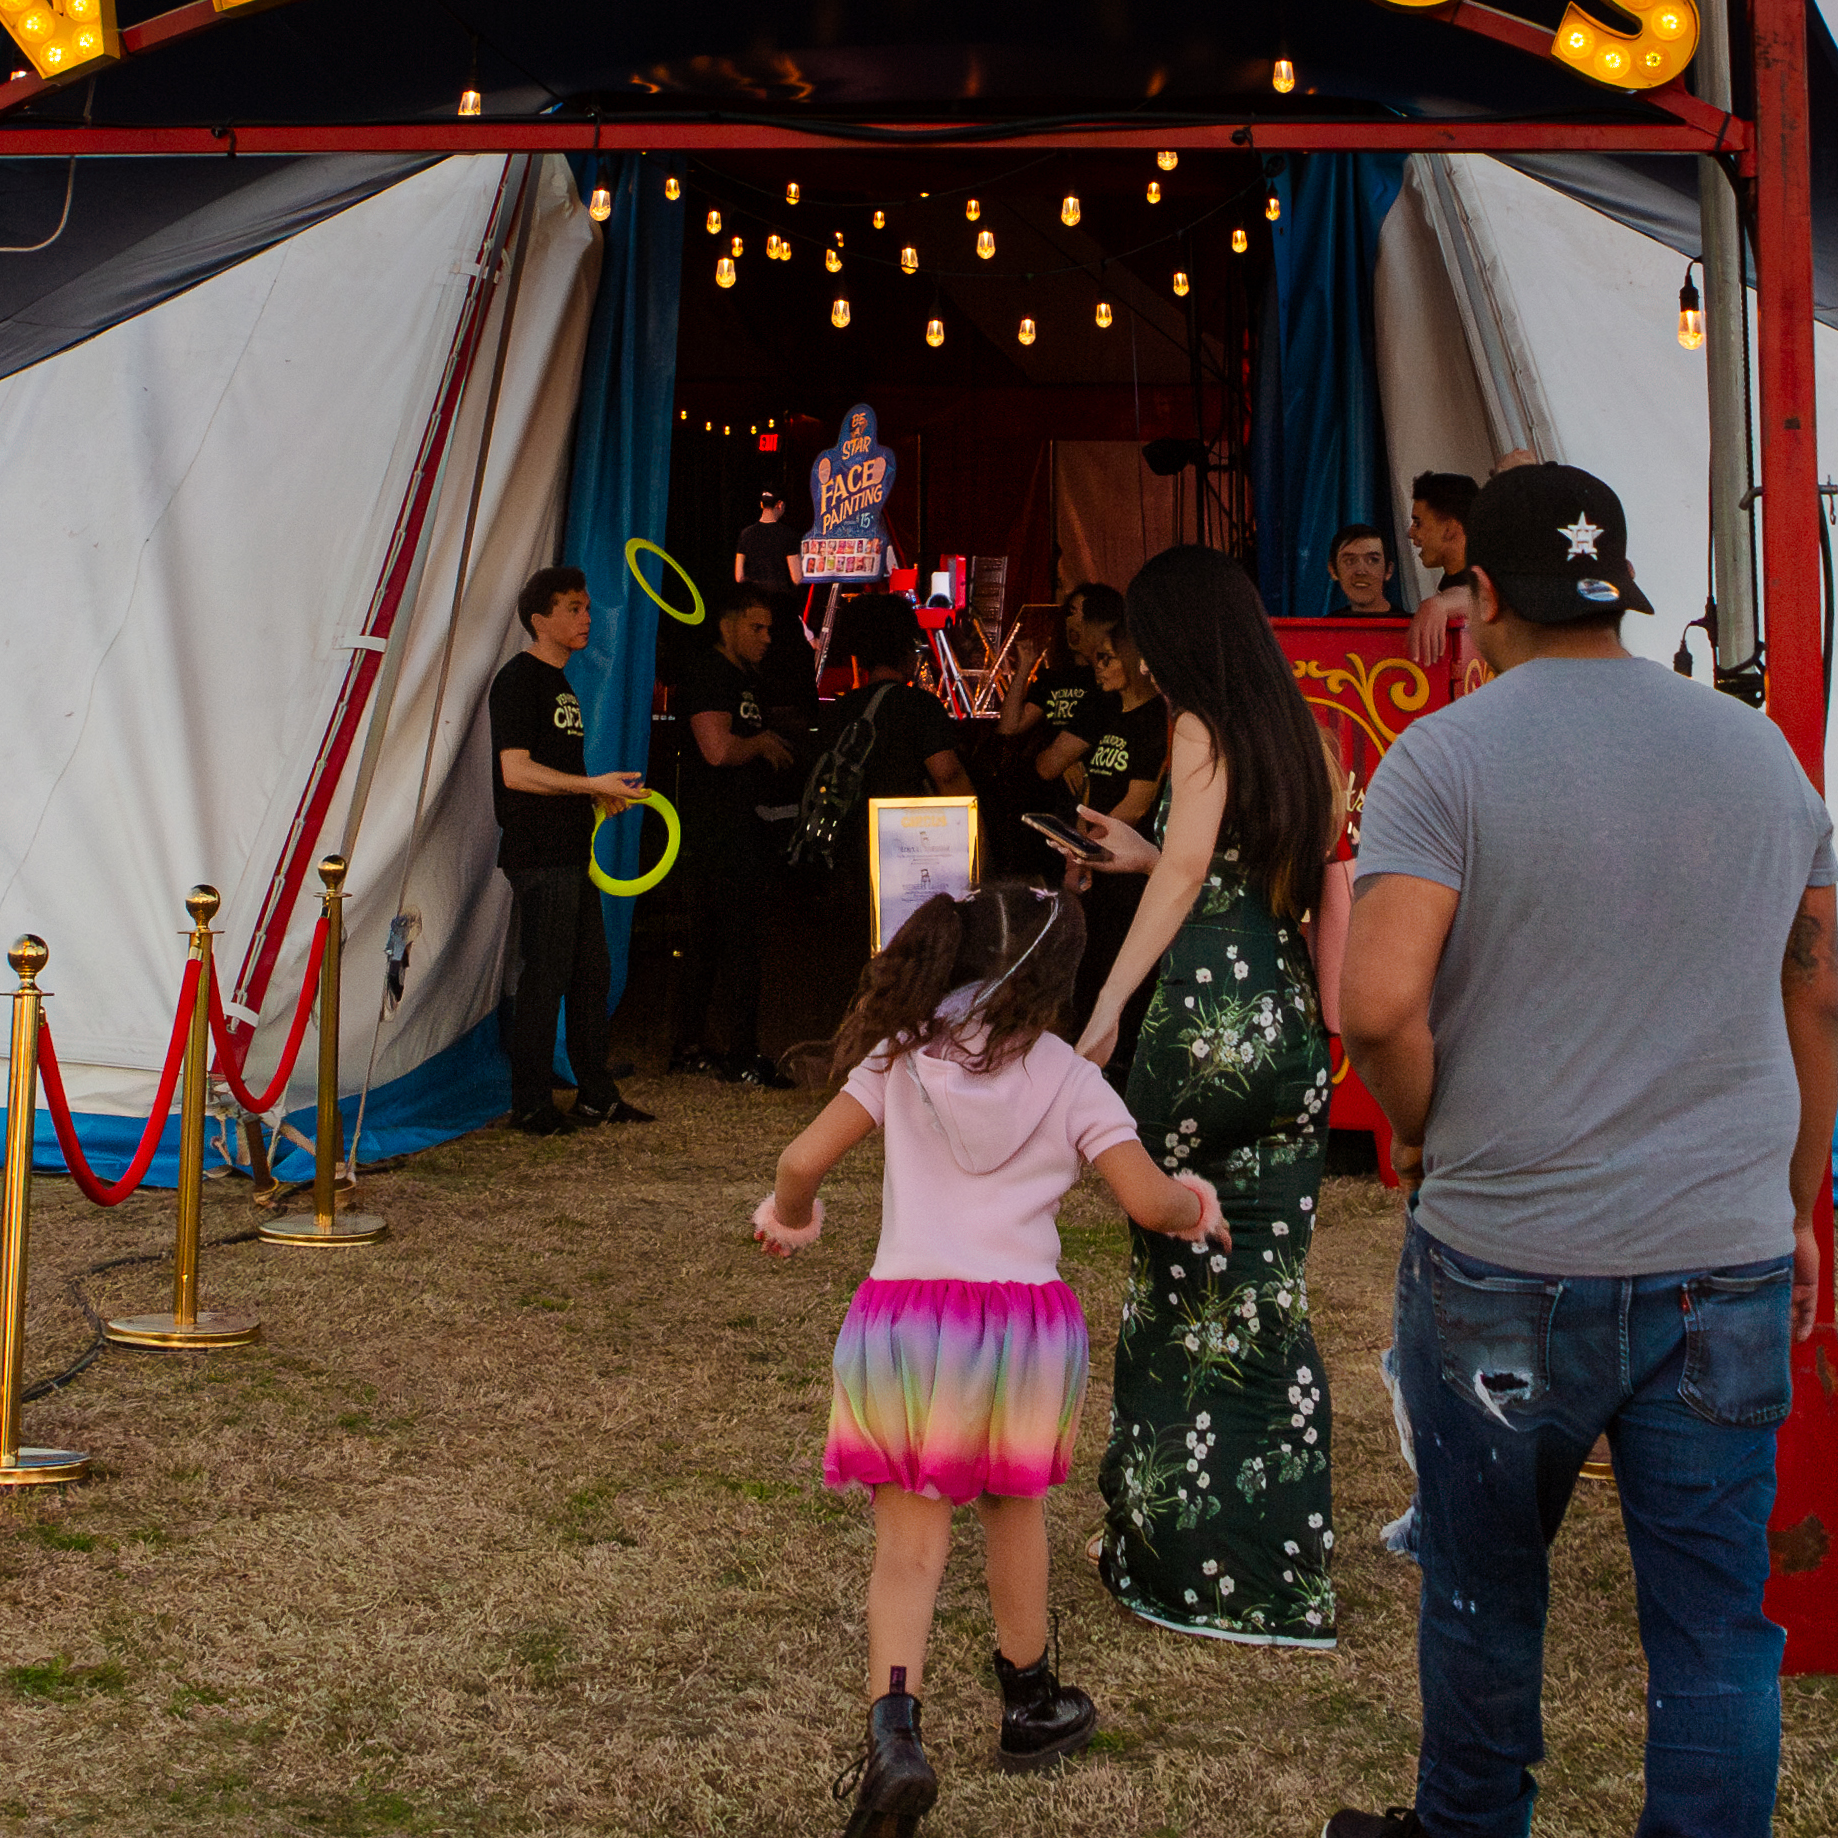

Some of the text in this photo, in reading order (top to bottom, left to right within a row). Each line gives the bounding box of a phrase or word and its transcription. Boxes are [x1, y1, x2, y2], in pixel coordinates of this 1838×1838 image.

[842, 435, 871, 460] STAR
[820, 459, 876, 516] FACE
[822, 484, 882, 535] PAINTING
